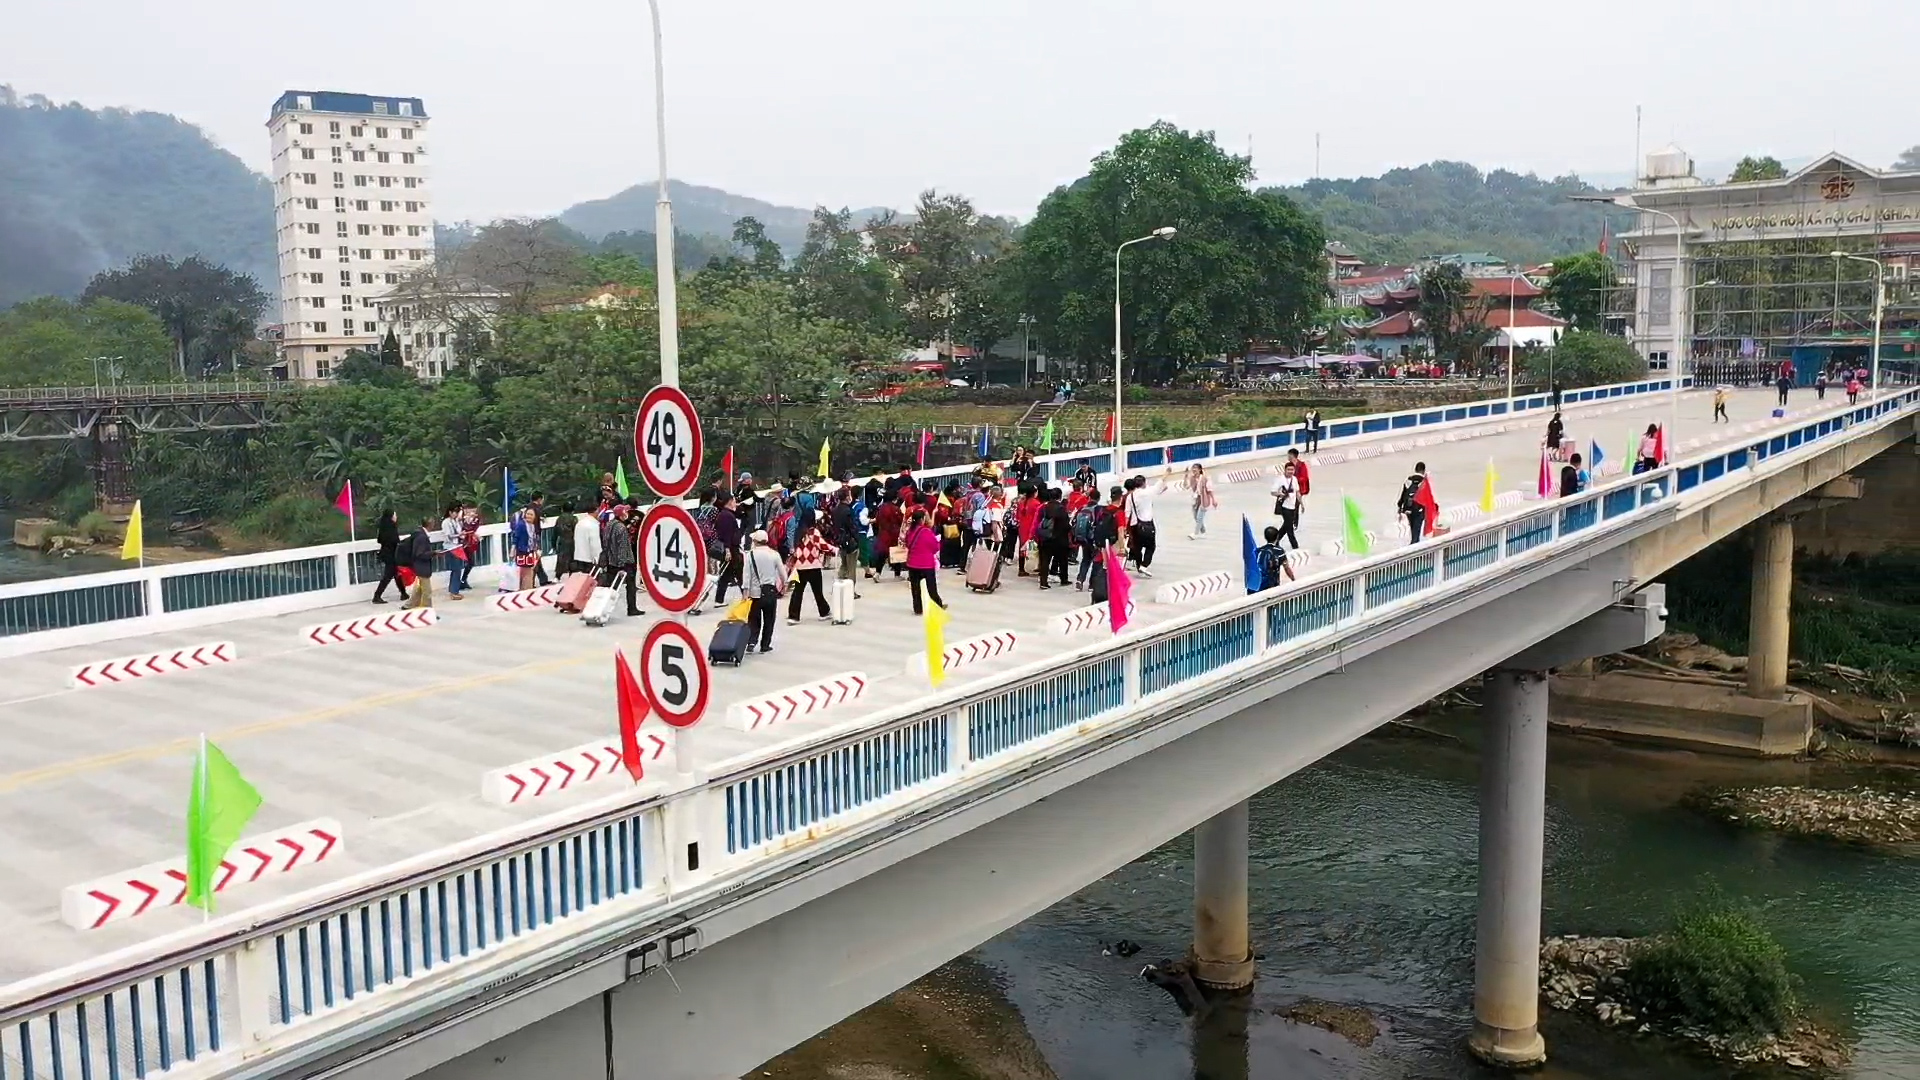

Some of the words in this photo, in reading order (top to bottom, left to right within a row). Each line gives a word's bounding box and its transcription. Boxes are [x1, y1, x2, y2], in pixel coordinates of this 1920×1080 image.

[647, 410, 685, 471] 49t
[654, 524, 689, 568] 14t
[661, 643, 688, 706] 5
